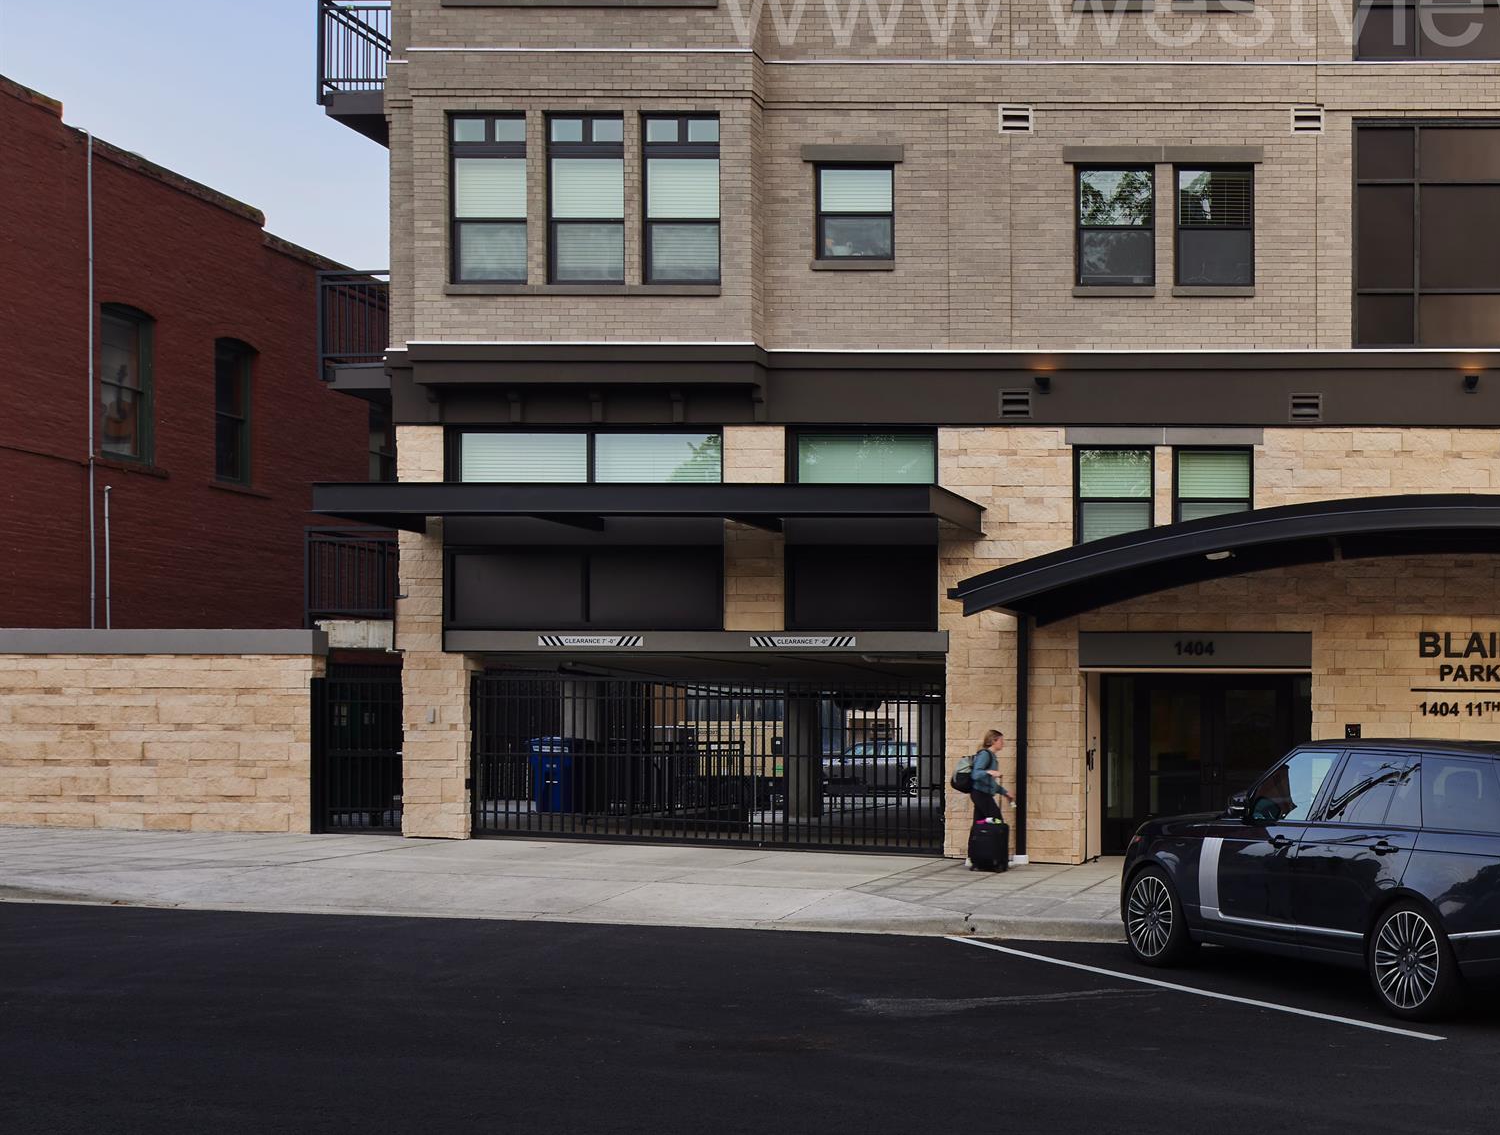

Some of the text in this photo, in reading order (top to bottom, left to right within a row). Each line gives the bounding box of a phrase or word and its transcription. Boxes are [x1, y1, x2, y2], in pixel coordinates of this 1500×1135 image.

[1174, 641, 1215, 656] 1404
[1440, 664, 1500, 682] PARK
[1420, 702, 1459, 717] 1404
